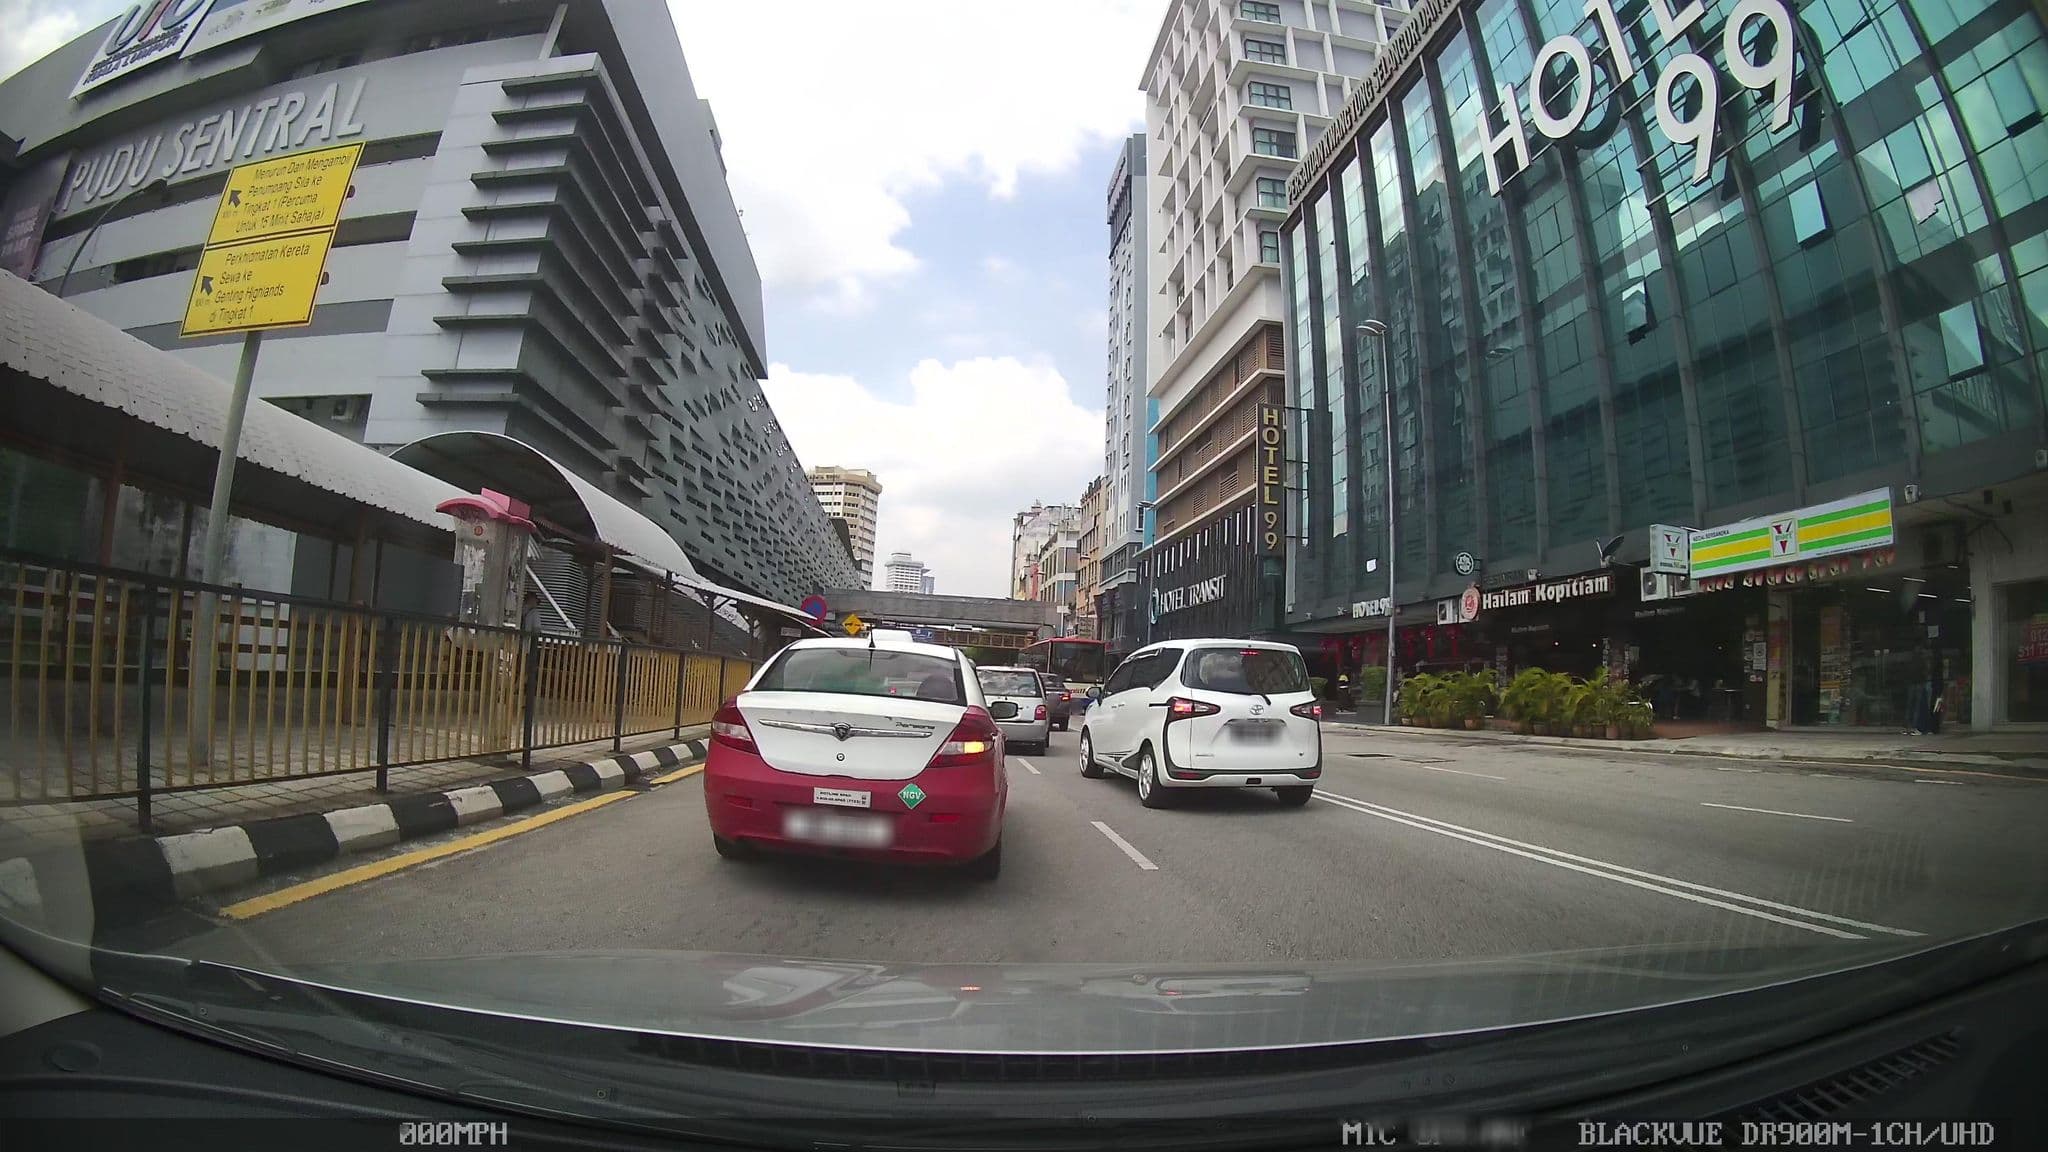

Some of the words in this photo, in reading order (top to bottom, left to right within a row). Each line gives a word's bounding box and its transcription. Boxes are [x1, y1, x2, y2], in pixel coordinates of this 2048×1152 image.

[1372, 19, 1421, 93] SELANGOR
[1655, 0, 1795, 188] 99
[62, 134, 164, 212] PUDU
[162, 76, 368, 180] SENTRAL
[287, 161, 305, 175] Dan
[312, 174, 324, 188] ke
[280, 243, 311, 258] Kereta
[219, 271, 242, 285] Sewa
[242, 269, 254, 281] ke
[214, 288, 245, 305] Genting
[245, 283, 286, 303] Highlands
[217, 306, 247, 325] Tingkat
[1262, 407, 1281, 506] HOTEL
[1263, 510, 1279, 551] 99
[1160, 586, 1184, 615] HOTEL
[1187, 573, 1227, 607] TRANSIT
[1481, 589, 1532, 610] Hailam
[1535, 575, 1609, 603] Kopitiam
[902, 790, 922, 800] NGV
